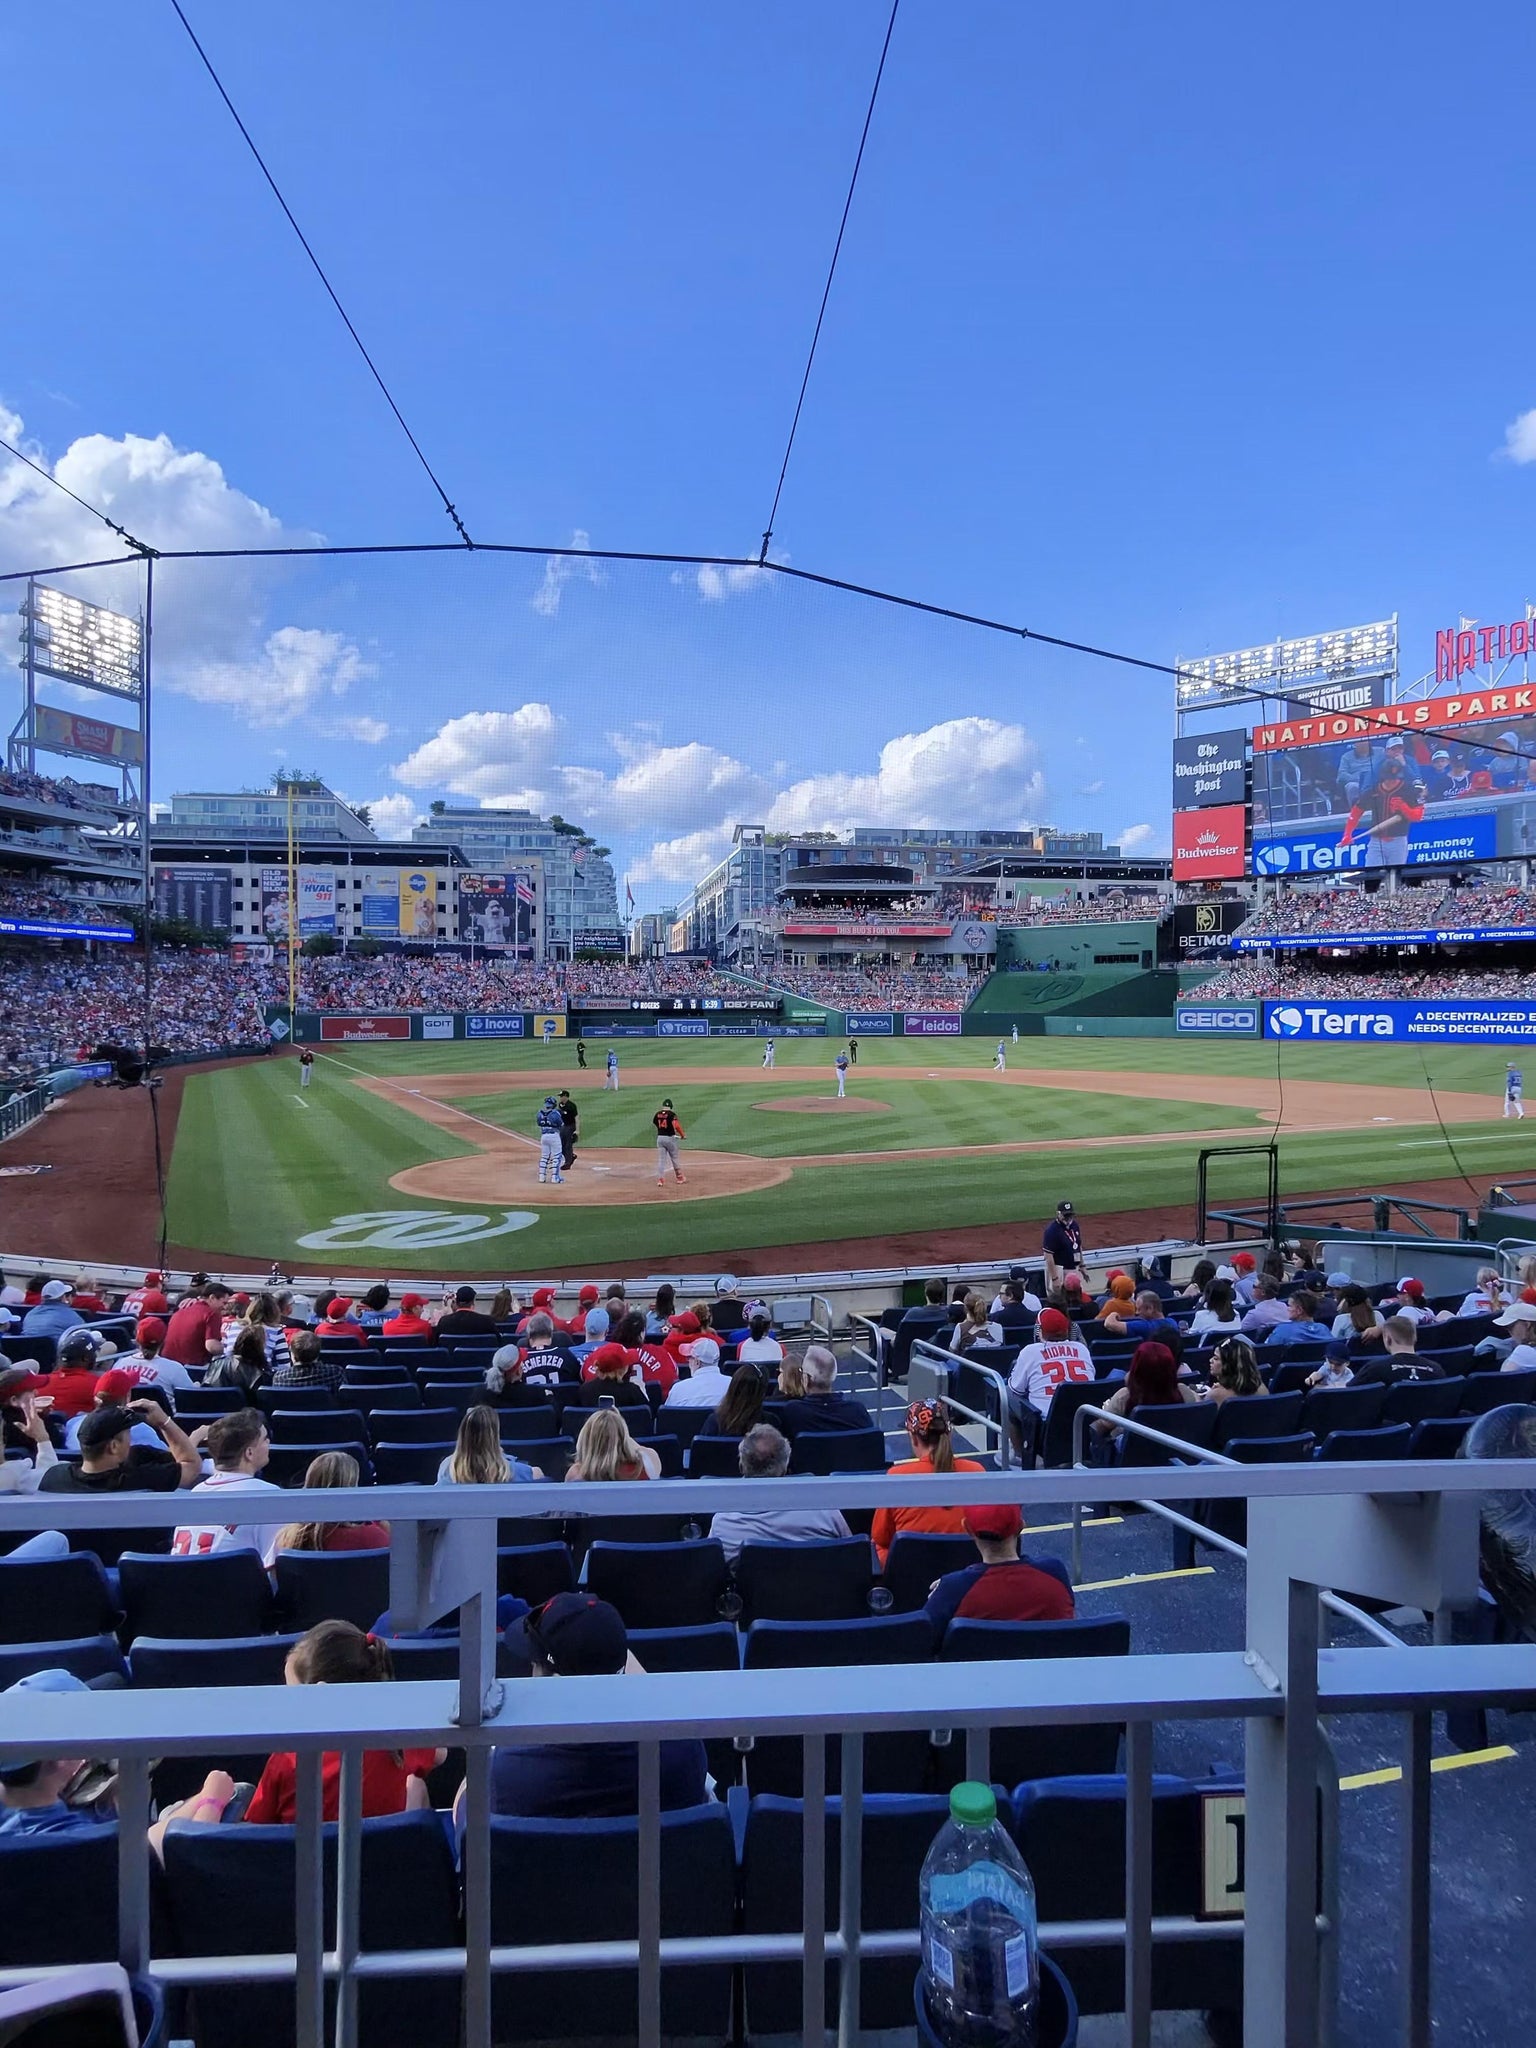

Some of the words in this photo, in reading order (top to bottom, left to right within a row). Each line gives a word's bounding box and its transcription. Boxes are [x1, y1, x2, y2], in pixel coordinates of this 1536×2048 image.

[1435, 619, 1536, 683] NATIO
[1298, 690, 1320, 701] SHOW
[1321, 685, 1342, 695] SOME
[1309, 685, 1372, 716] NATITUDE
[1261, 706, 1430, 745] NATIONALS
[1446, 690, 1533, 718] PARK
[1197, 743, 1219, 757] The
[1175, 758, 1242, 777] Washington
[1194, 778, 1221, 796] Post
[1408, 836, 1474, 853] erra.money
[1177, 845, 1238, 859] Budweiser
[1293, 843, 1368, 871] Terr
[1416, 848, 1475, 862] #LUNAtic
[315, 892, 333, 901] 911
[0, 921, 16, 931] erra
[1448, 932, 1475, 940] Terra
[1250, 939, 1271, 948] Terra
[640, 1001, 660, 1009] ROGERS
[704, 1000, 718, 1009] 5:39
[1179, 1012, 1254, 1028] GEICO
[1305, 1008, 1394, 1035] Terra
[1415, 1012, 1424, 1021] A
[1426, 1012, 1526, 1022] DECENTRALIZED
[425, 1020, 451, 1028] GDIT
[485, 1018, 520, 1029] Inova
[674, 1023, 704, 1033] Terra
[923, 1020, 959, 1031] leidos
[1408, 1024, 1446, 1033] NEEDS
[343, 1031, 389, 1039] Budweiser
